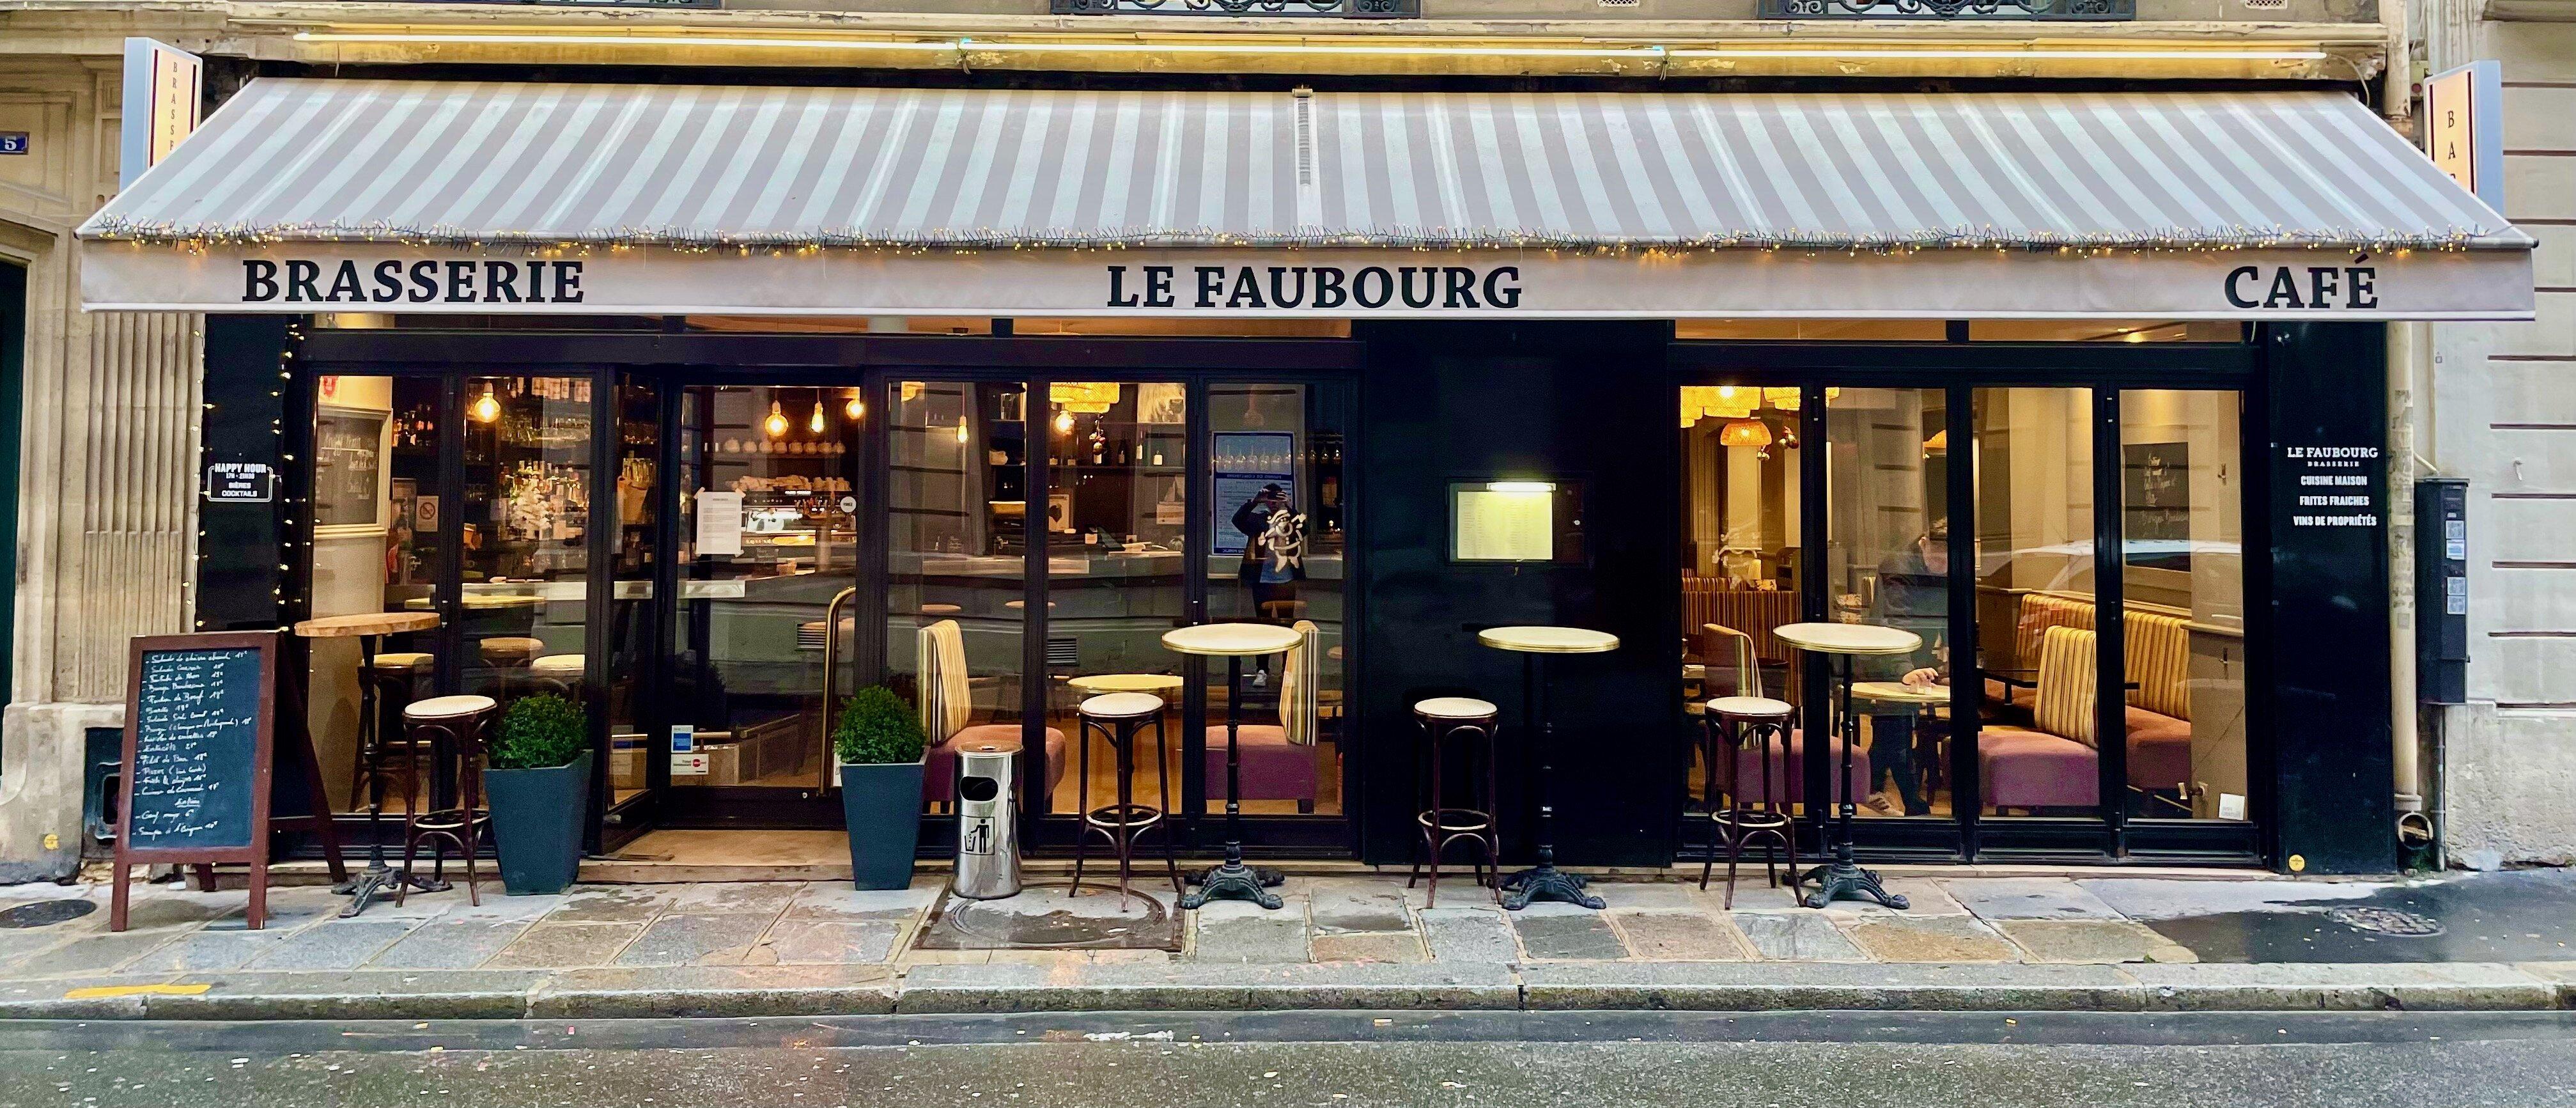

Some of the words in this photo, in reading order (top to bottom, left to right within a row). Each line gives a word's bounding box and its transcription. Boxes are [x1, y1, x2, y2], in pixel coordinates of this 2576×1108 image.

[4, 136, 17, 151] 5
[2447, 110, 2456, 179] BA
[242, 260, 584, 303] BRASSERIE
[1107, 265, 1175, 308] LE
[1194, 266, 1522, 309] FAUBOURG
[2224, 253, 2378, 309] CAFÉ
[2287, 447, 2304, 458] LE
[2306, 447, 2378, 458] FAUBOURG
[214, 463, 243, 473] HAPPY
[244, 463, 267, 474] HOUR
[2301, 475, 2334, 486] CUISINE
[2334, 475, 2368, 486] MAISON
[2299, 495, 2328, 506] FRITES
[2329, 495, 2370, 506] FRAICHES
[2293, 515, 2314, 526] VINS
[2315, 515, 2326, 526] DE
[2327, 514, 2377, 526] PROPRIÉTÉS
